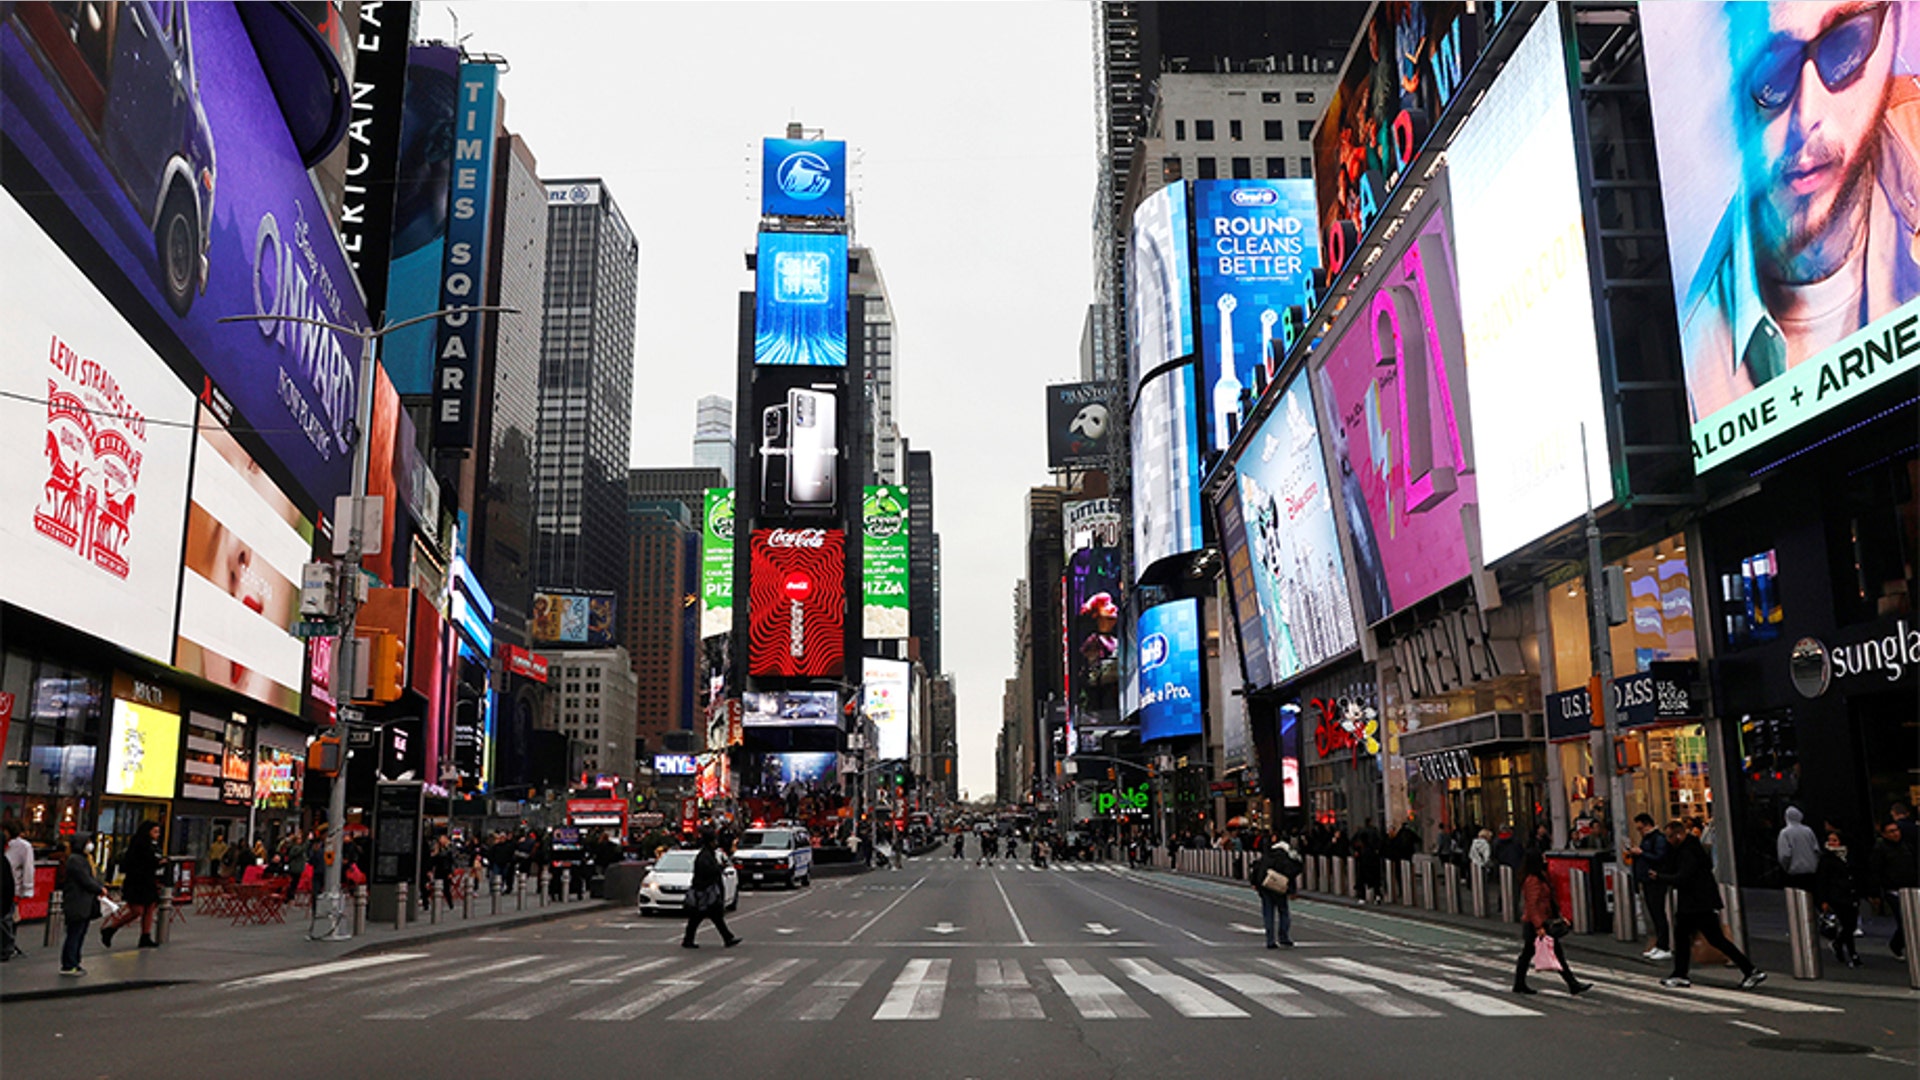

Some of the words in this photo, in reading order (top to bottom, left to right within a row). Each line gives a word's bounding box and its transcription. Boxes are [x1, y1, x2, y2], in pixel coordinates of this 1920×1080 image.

[454, 82, 485, 219] TIMES
[1214, 216, 1303, 236] ROUND
[1216, 236, 1304, 255] CLEANS
[1219, 256, 1302, 275] BETTER
[253, 211, 357, 454] ONWARD
[440, 242, 473, 422] SQUARE
[49, 334, 78, 382] LEVI
[767, 528, 827, 548] Coca-Cola
[1164, 682, 1191, 700] Pro.
